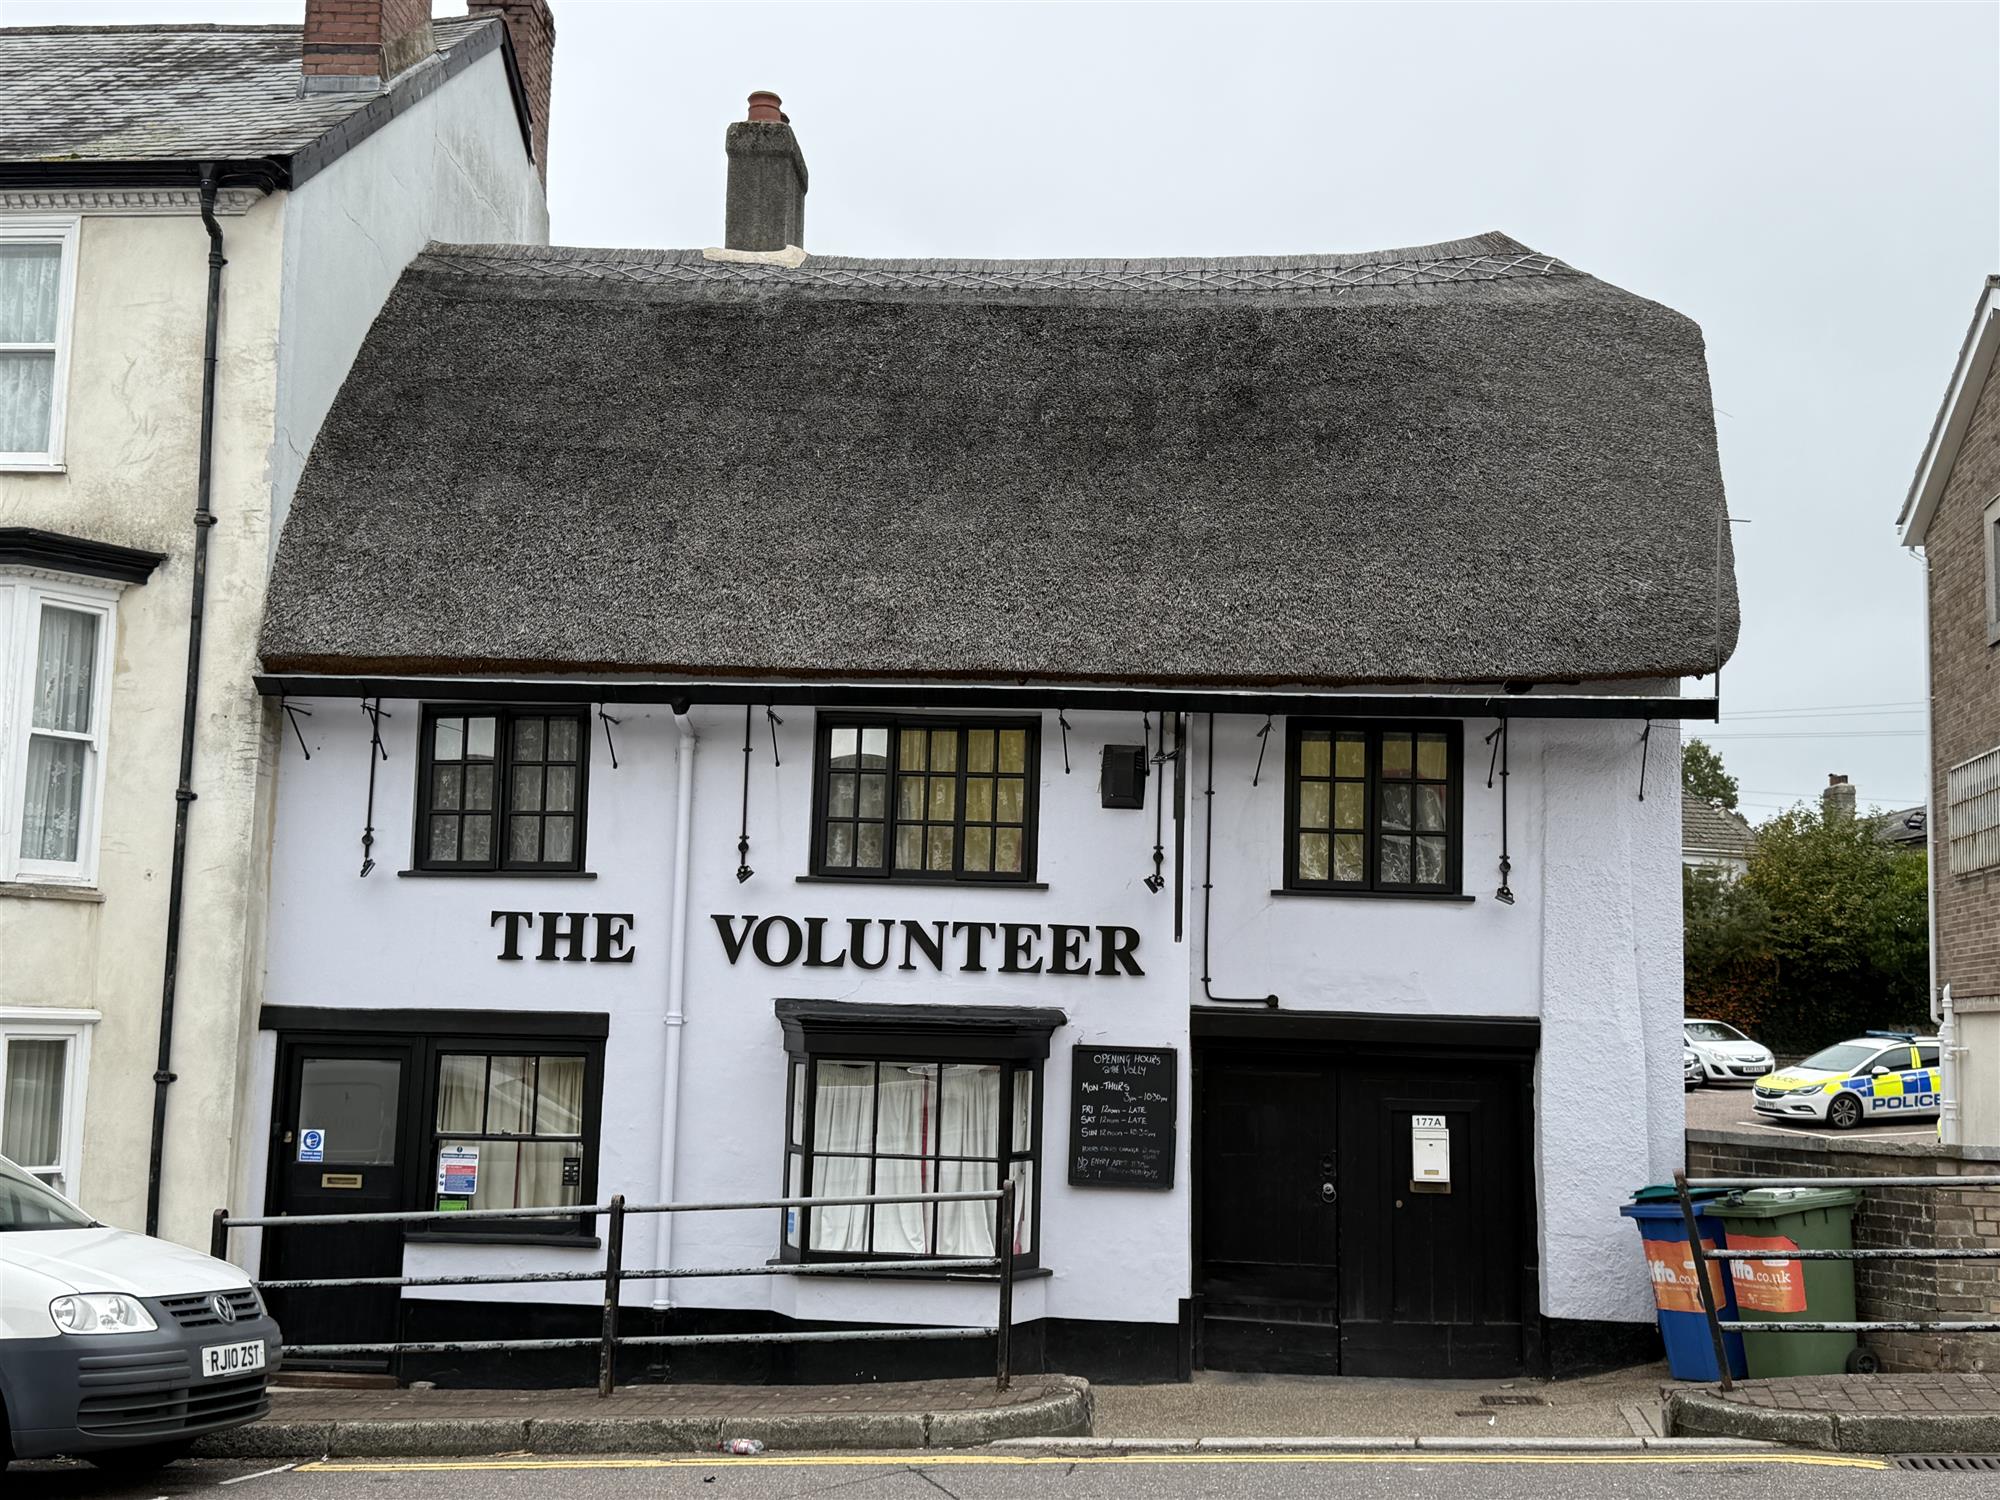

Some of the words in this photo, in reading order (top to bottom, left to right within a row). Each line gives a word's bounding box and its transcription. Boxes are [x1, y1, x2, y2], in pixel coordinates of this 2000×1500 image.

[490, 911, 635, 963] THE
[710, 914, 1145, 976] VOLUNTEER
[1093, 1053, 1131, 1067] OPENING
[1134, 1054, 1161, 1066] HOURS
[1123, 1065, 1147, 1077] VOLLY
[1872, 1093, 1941, 1110] POLICE
[1081, 1104, 1094, 1114] FRI
[1128, 1105, 1147, 1114] LATE
[1080, 1115, 1096, 1124] SAT
[1127, 1116, 1148, 1125] LATE
[1416, 1117, 1441, 1126] 177A
[1081, 1127, 1098, 1138] SUN
[211, 1347, 239, 1372] RJ10
[240, 1344, 260, 1367] ZST
